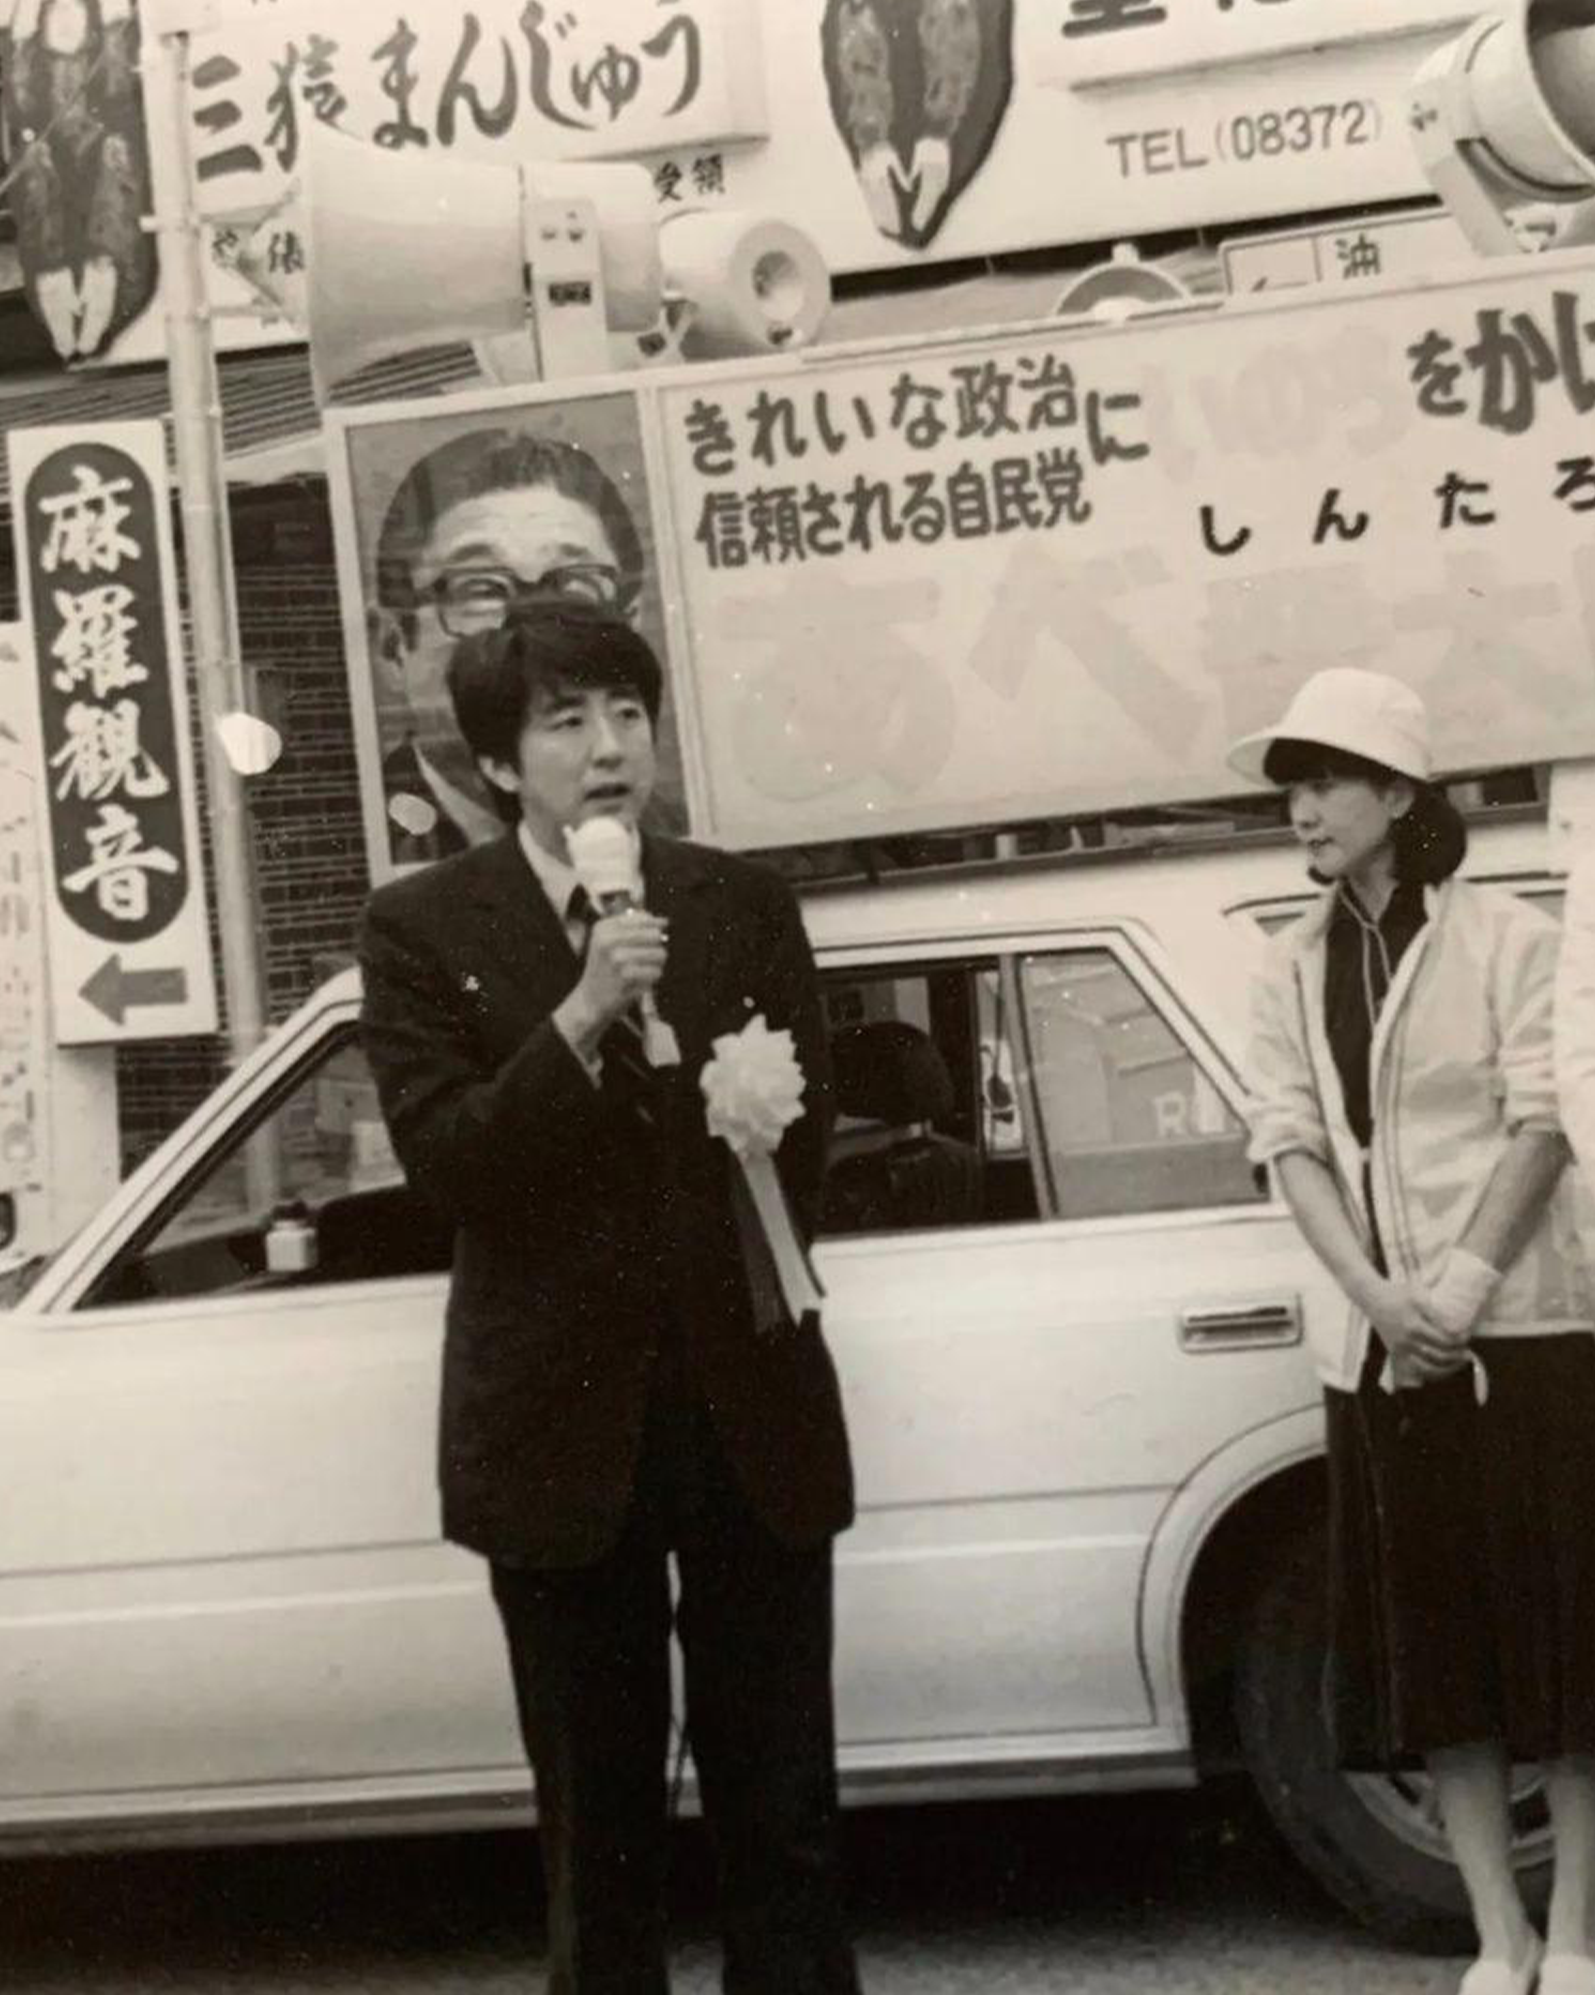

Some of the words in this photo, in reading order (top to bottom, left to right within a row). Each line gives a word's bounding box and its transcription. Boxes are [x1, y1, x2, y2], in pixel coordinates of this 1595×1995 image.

[684, 354, 1150, 475] きれいな政治に
[696, 447, 1092, 569] 信頼される自民党
[40, 465, 179, 920] 麻羅観音
